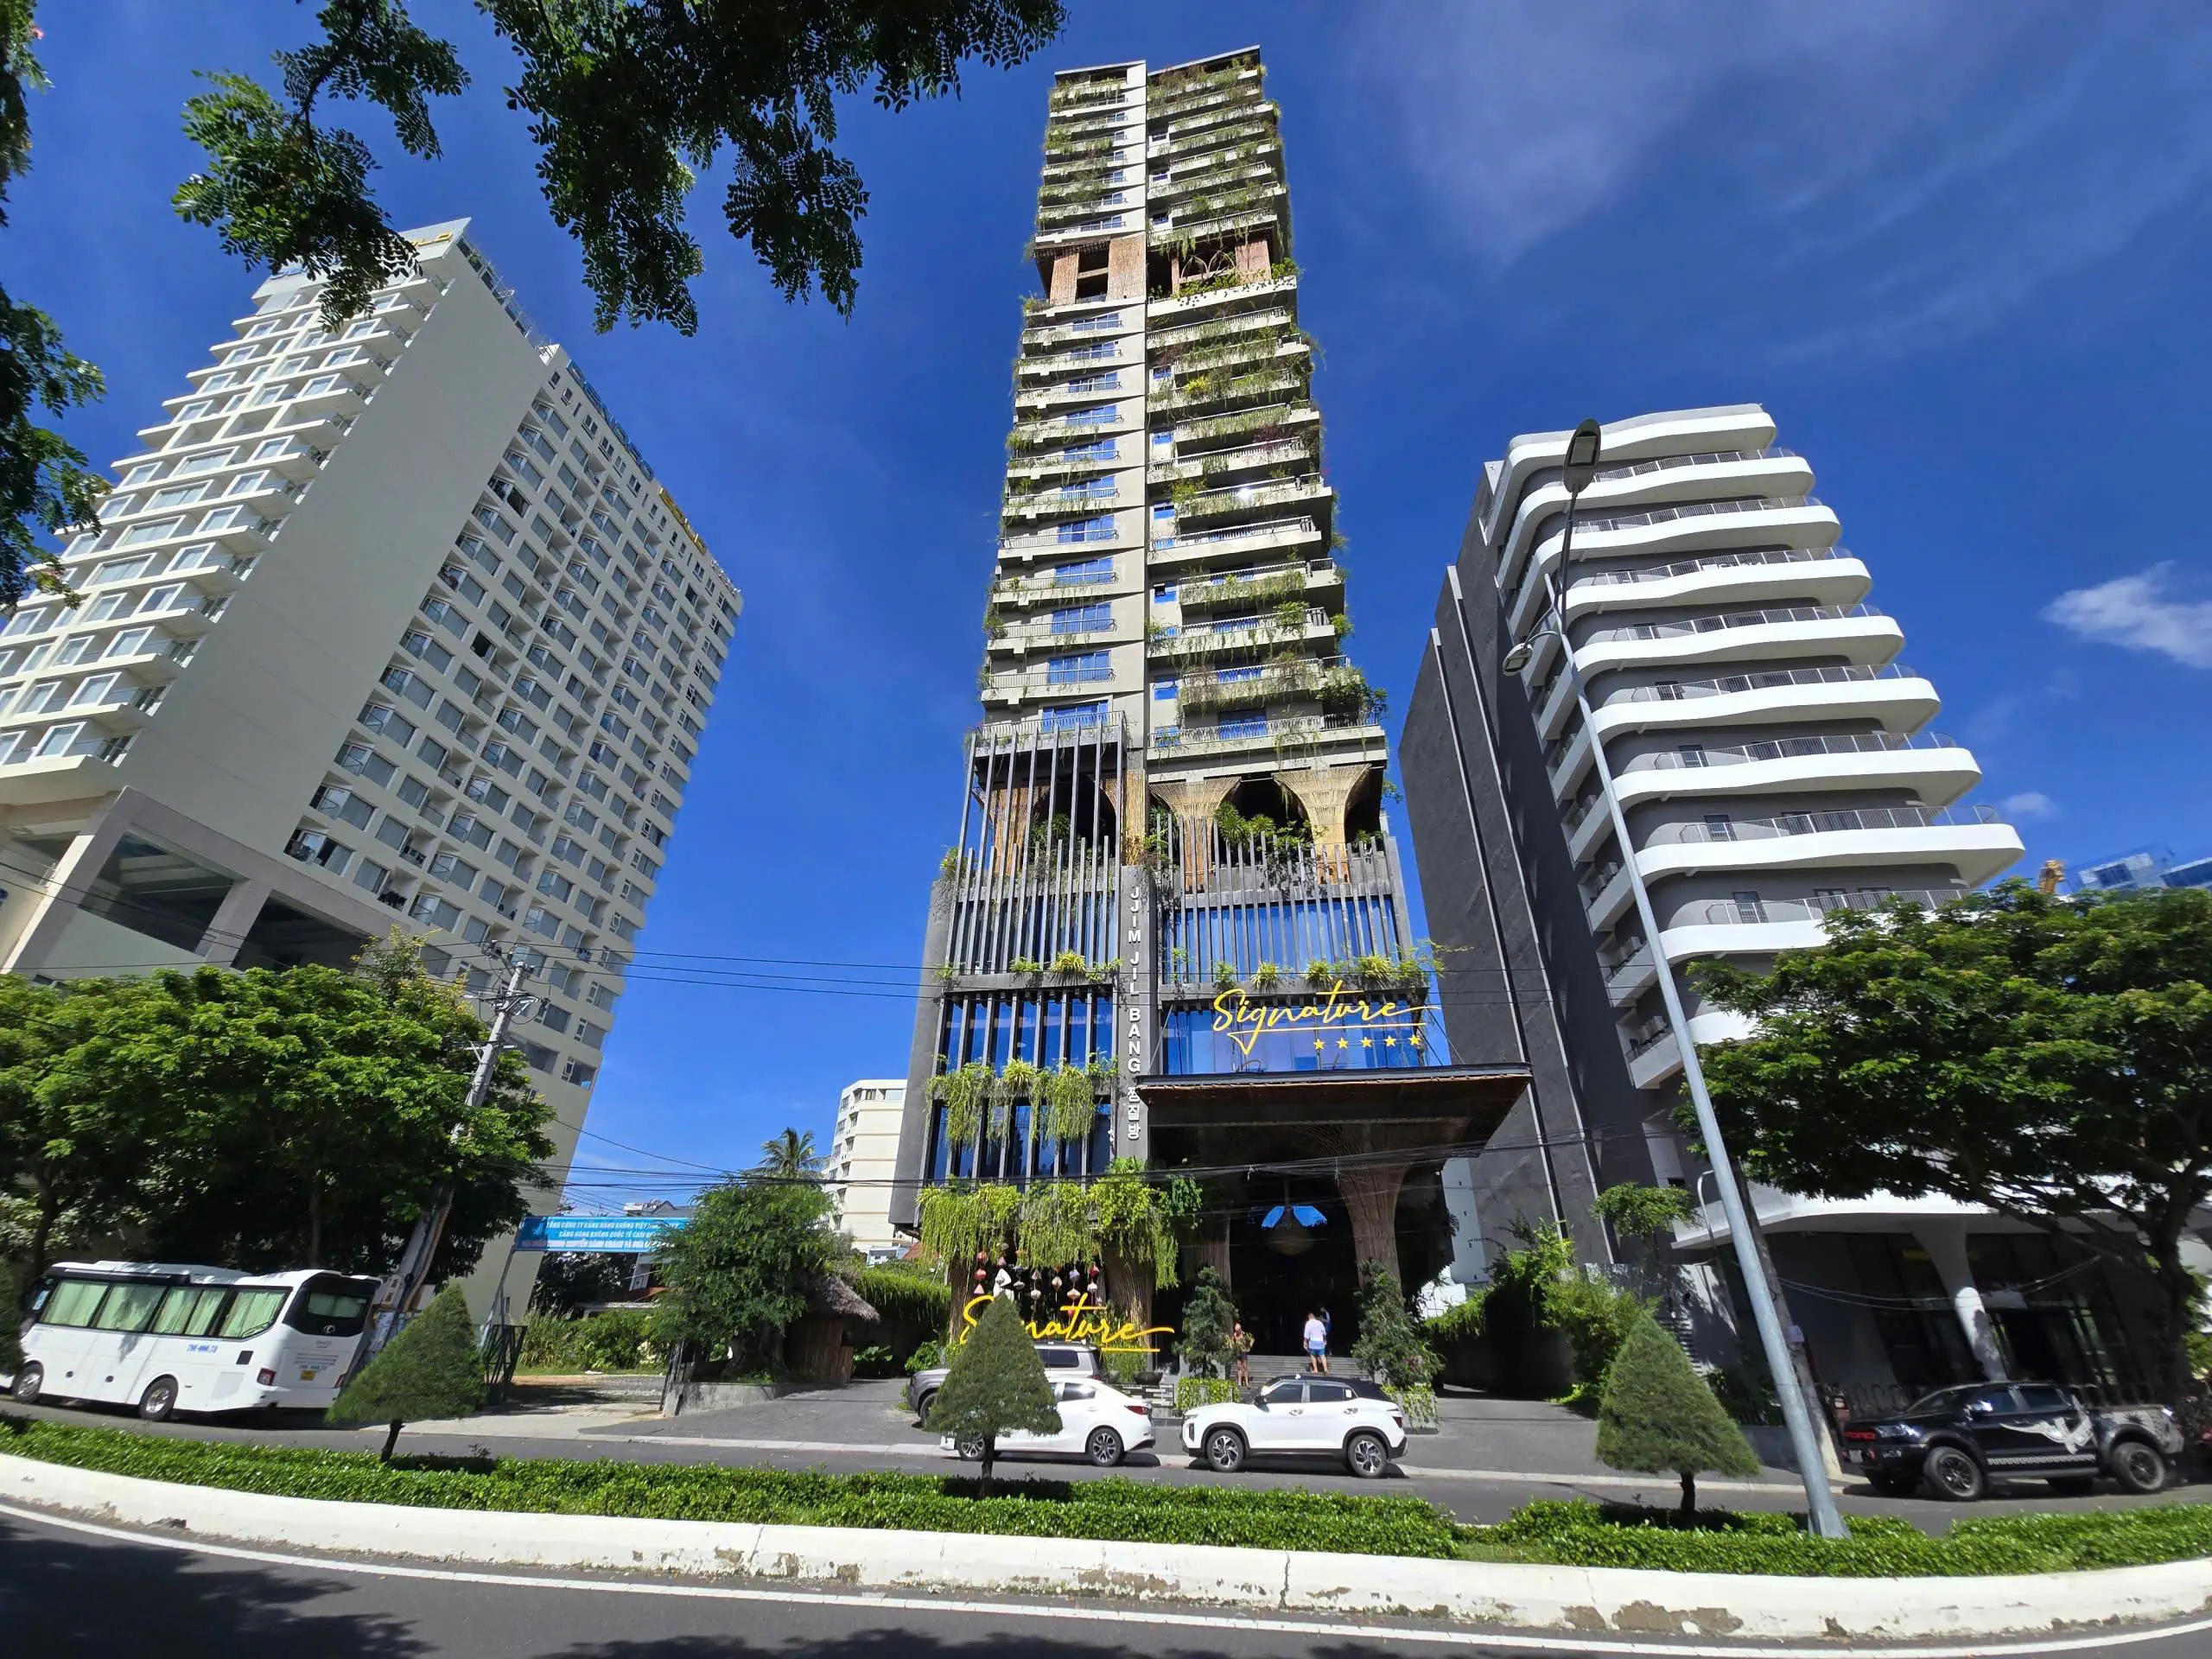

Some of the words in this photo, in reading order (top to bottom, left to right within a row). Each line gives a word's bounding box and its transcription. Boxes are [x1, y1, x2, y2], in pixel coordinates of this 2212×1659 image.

[1128, 887, 1141, 944] JJIM
[1129, 951, 1140, 996] JIL
[1128, 1007, 1141, 1072] BANG
[1212, 979, 1441, 1056] Signature
